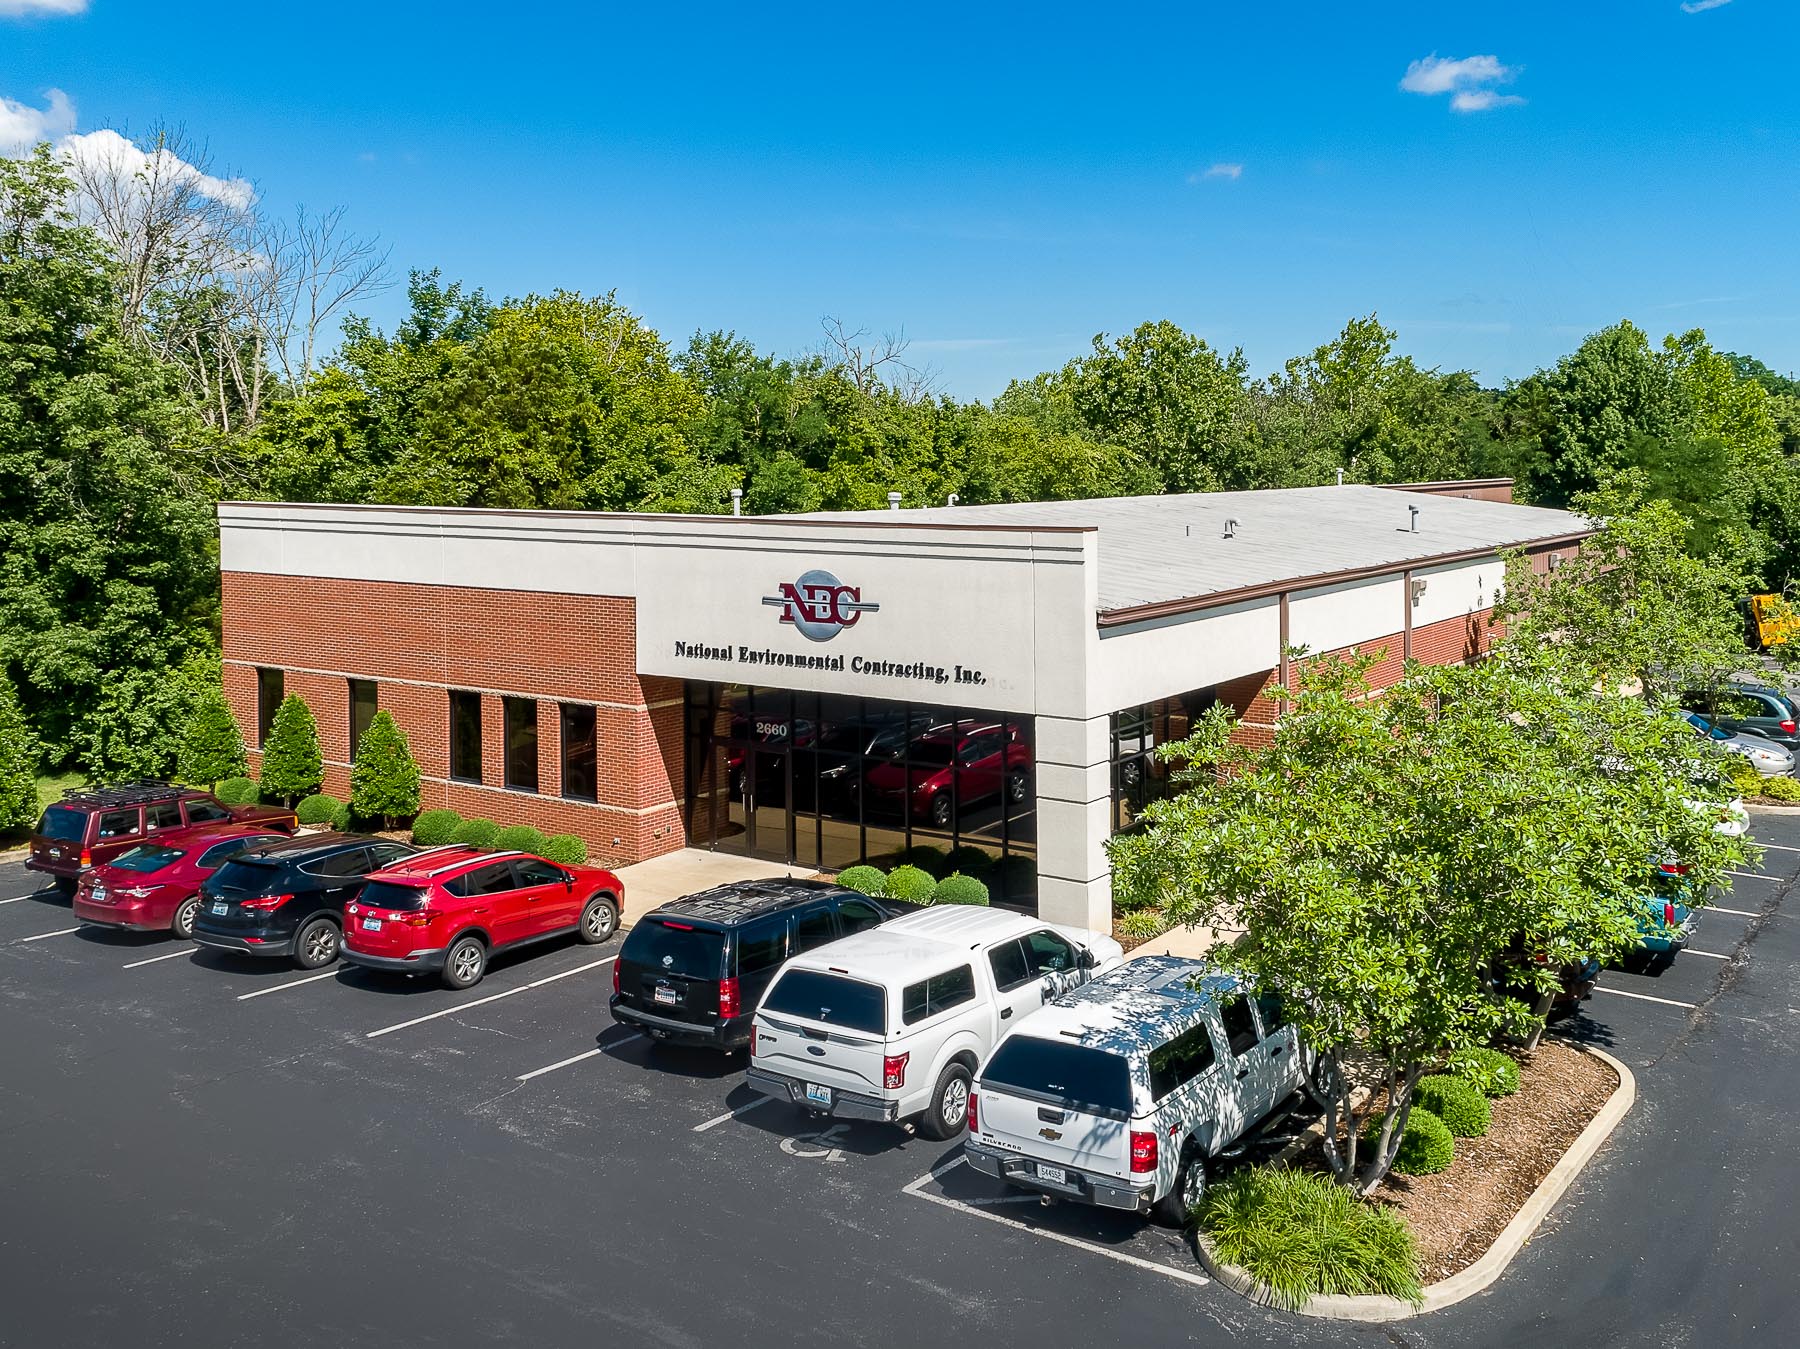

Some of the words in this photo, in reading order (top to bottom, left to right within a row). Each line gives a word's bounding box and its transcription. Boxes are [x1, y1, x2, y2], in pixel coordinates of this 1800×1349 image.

[674, 640, 733, 661] National
[738, 646, 845, 671] Environmental
[851, 655, 950, 684] Contracting,
[954, 665, 987, 685] Inc.
[756, 722, 787, 736] 2660
